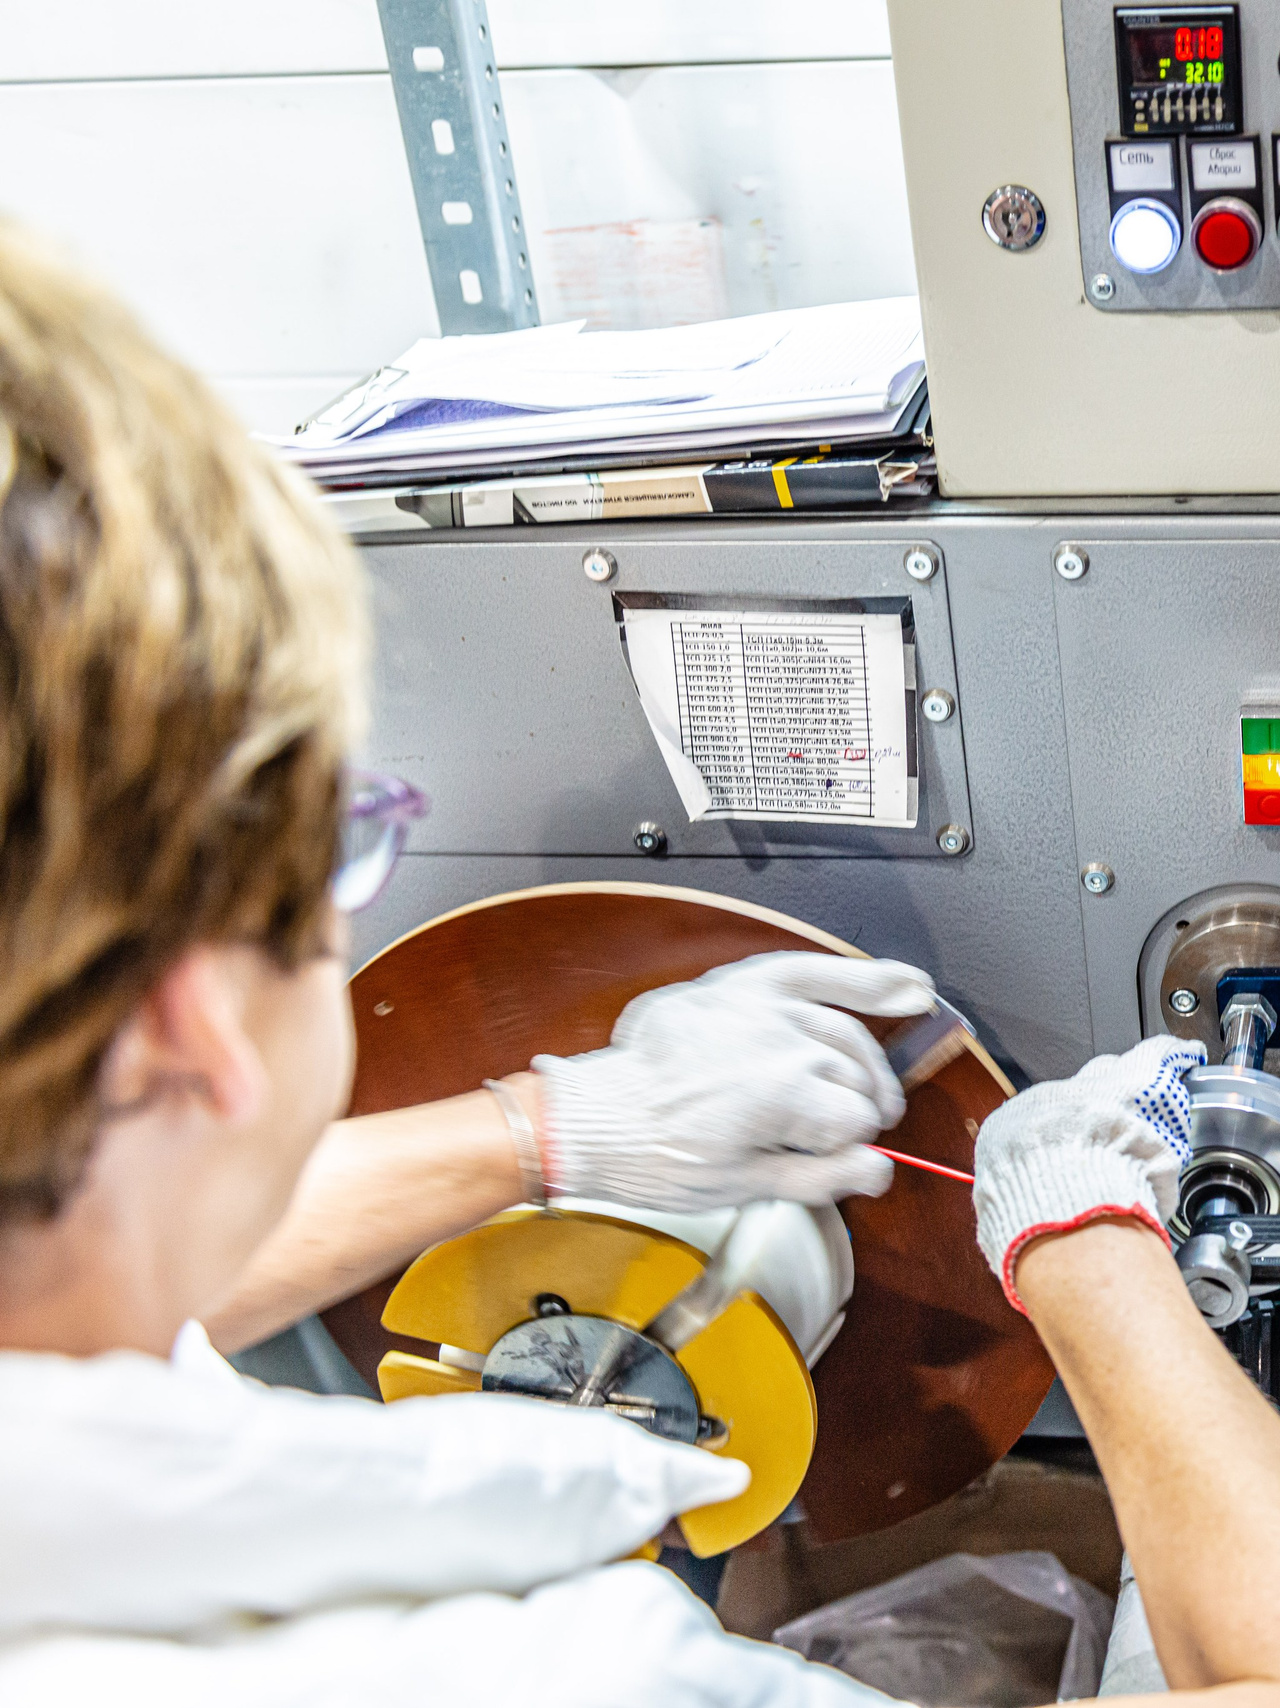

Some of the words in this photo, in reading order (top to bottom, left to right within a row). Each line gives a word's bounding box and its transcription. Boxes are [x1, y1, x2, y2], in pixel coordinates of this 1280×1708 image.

[1119, 147, 1154, 165] Сеть
[1209, 147, 1237, 161] Сброс
[1207, 162, 1242, 175] Аварии
